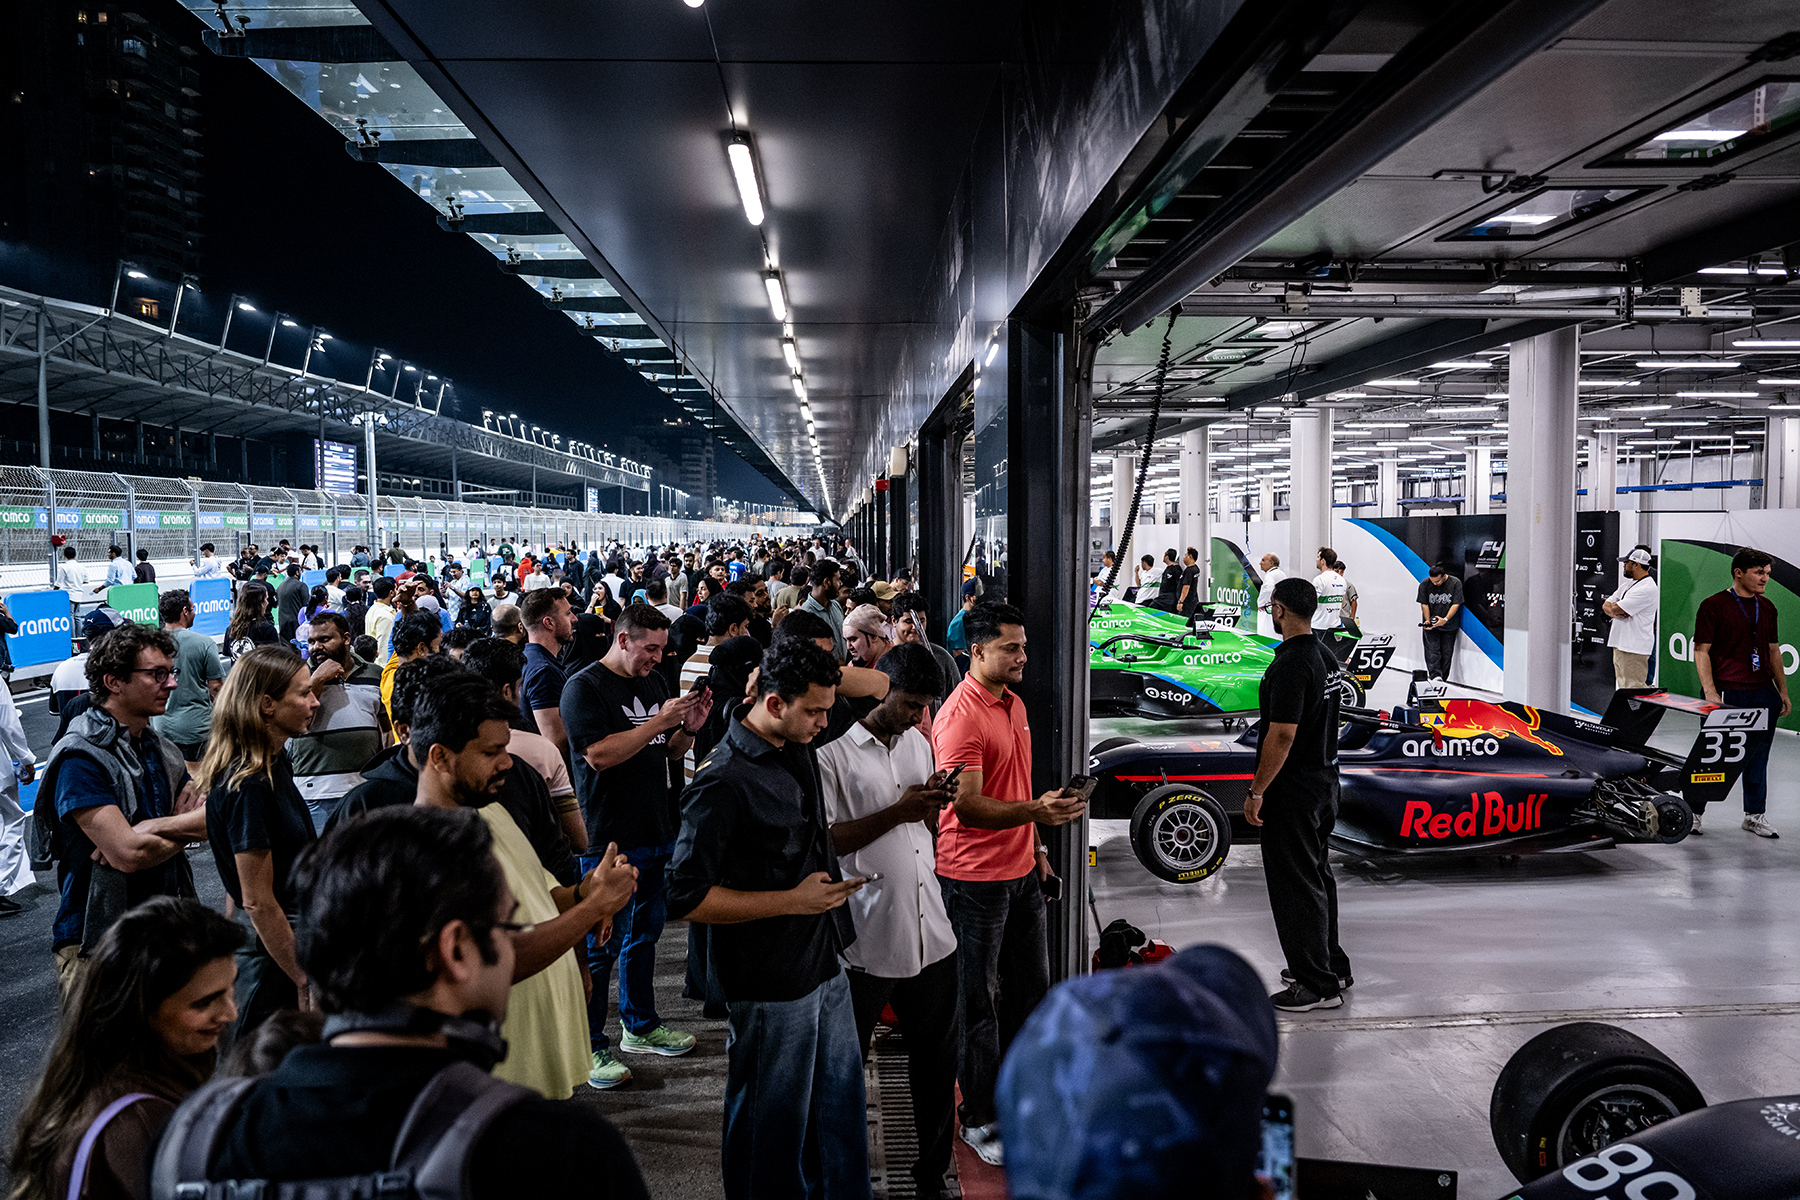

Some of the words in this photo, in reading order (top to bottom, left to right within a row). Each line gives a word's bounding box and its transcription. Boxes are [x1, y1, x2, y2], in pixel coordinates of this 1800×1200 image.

[85, 514, 119, 524] aramco
[162, 515, 191, 525] aramco
[8, 616, 70, 639] ramco
[1183, 652, 1242, 665] aramco
[1358, 650, 1385, 669] 56
[1402, 739, 1499, 757] aramco
[1700, 731, 1748, 763] 33
[1168, 794, 1203, 804] ZERO
[1400, 792, 1480, 839] Red
[1482, 790, 1548, 836] Bull
